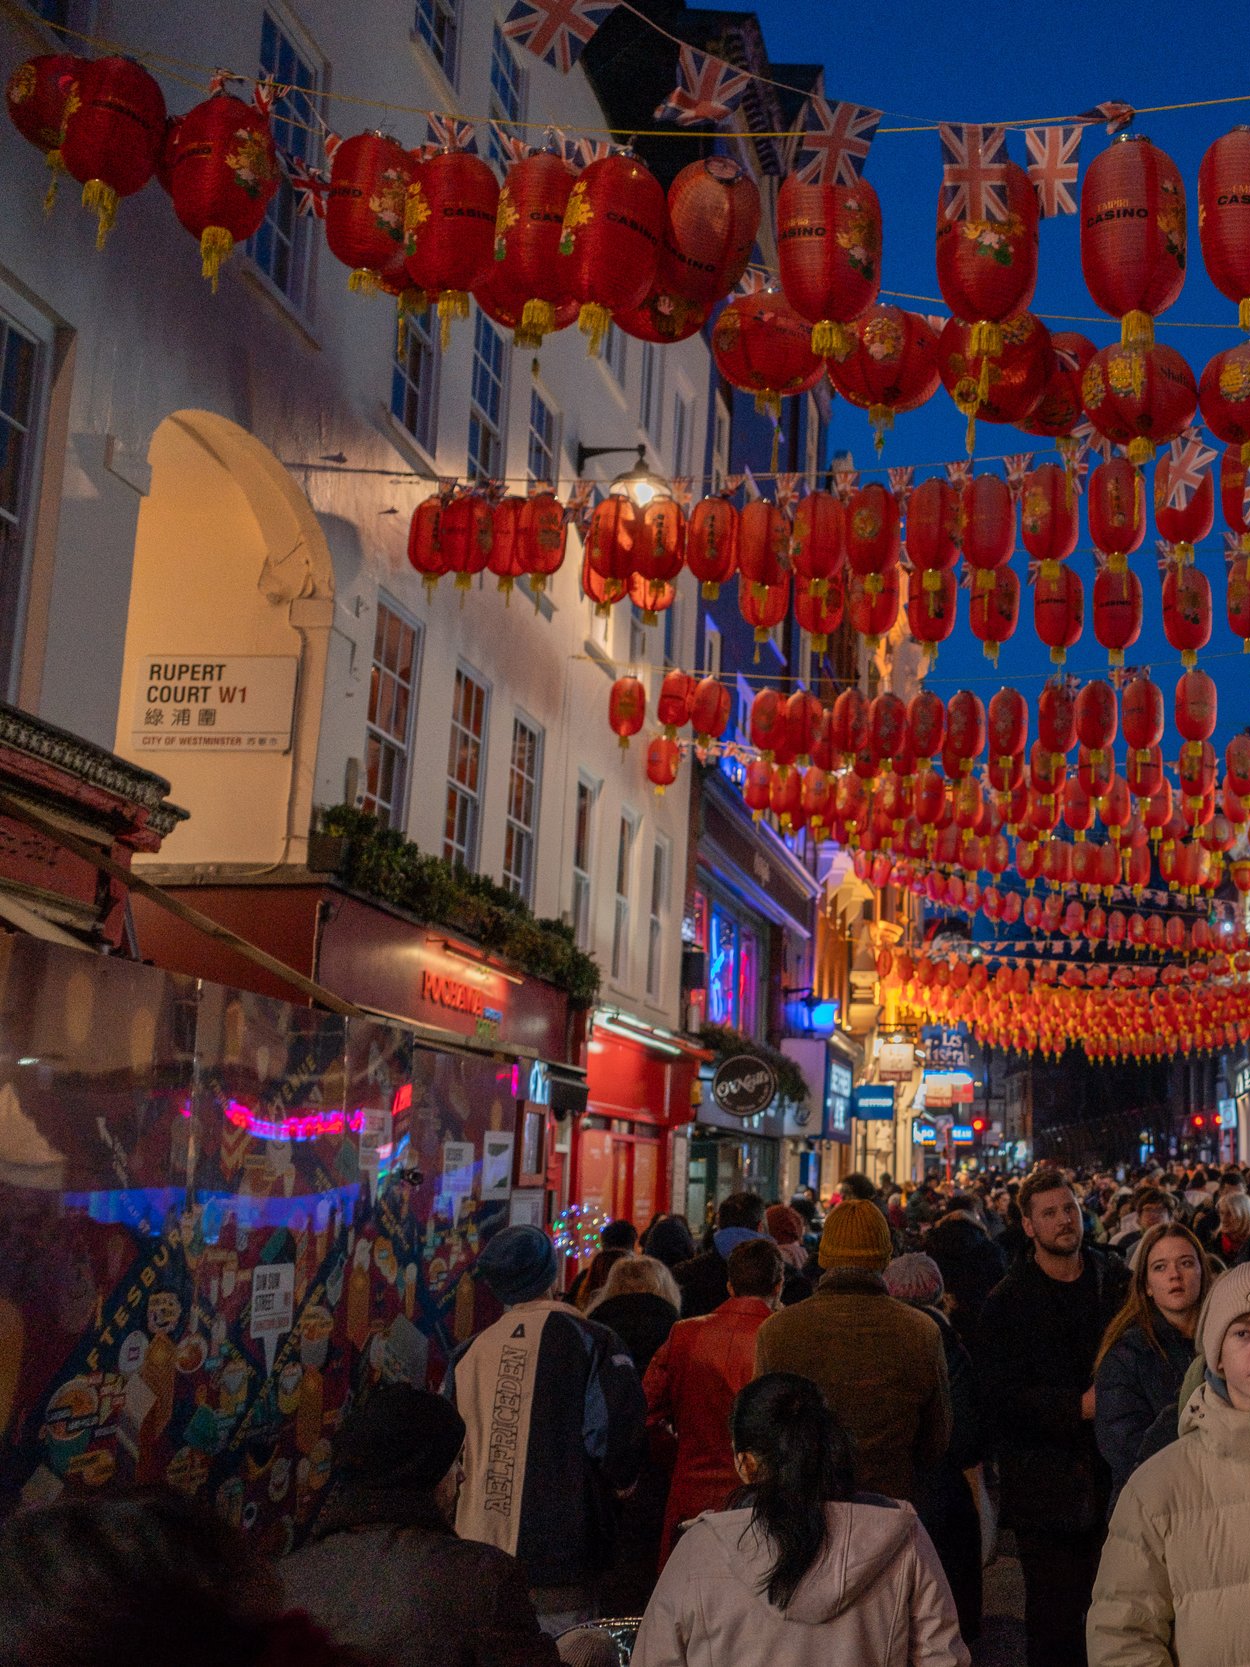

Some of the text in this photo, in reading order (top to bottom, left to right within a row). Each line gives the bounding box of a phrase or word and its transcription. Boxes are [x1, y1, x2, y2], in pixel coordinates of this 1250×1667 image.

[1087, 208, 1149, 228] CASINO
[149, 663, 226, 681] RUPERT
[146, 685, 247, 703] COURT W1
[142, 736, 162, 746] CITY
[164, 736, 176, 745] OF
[179, 736, 242, 746] WESTMINSTER
[484, 1345, 528, 1518] AELFRICEDEN
